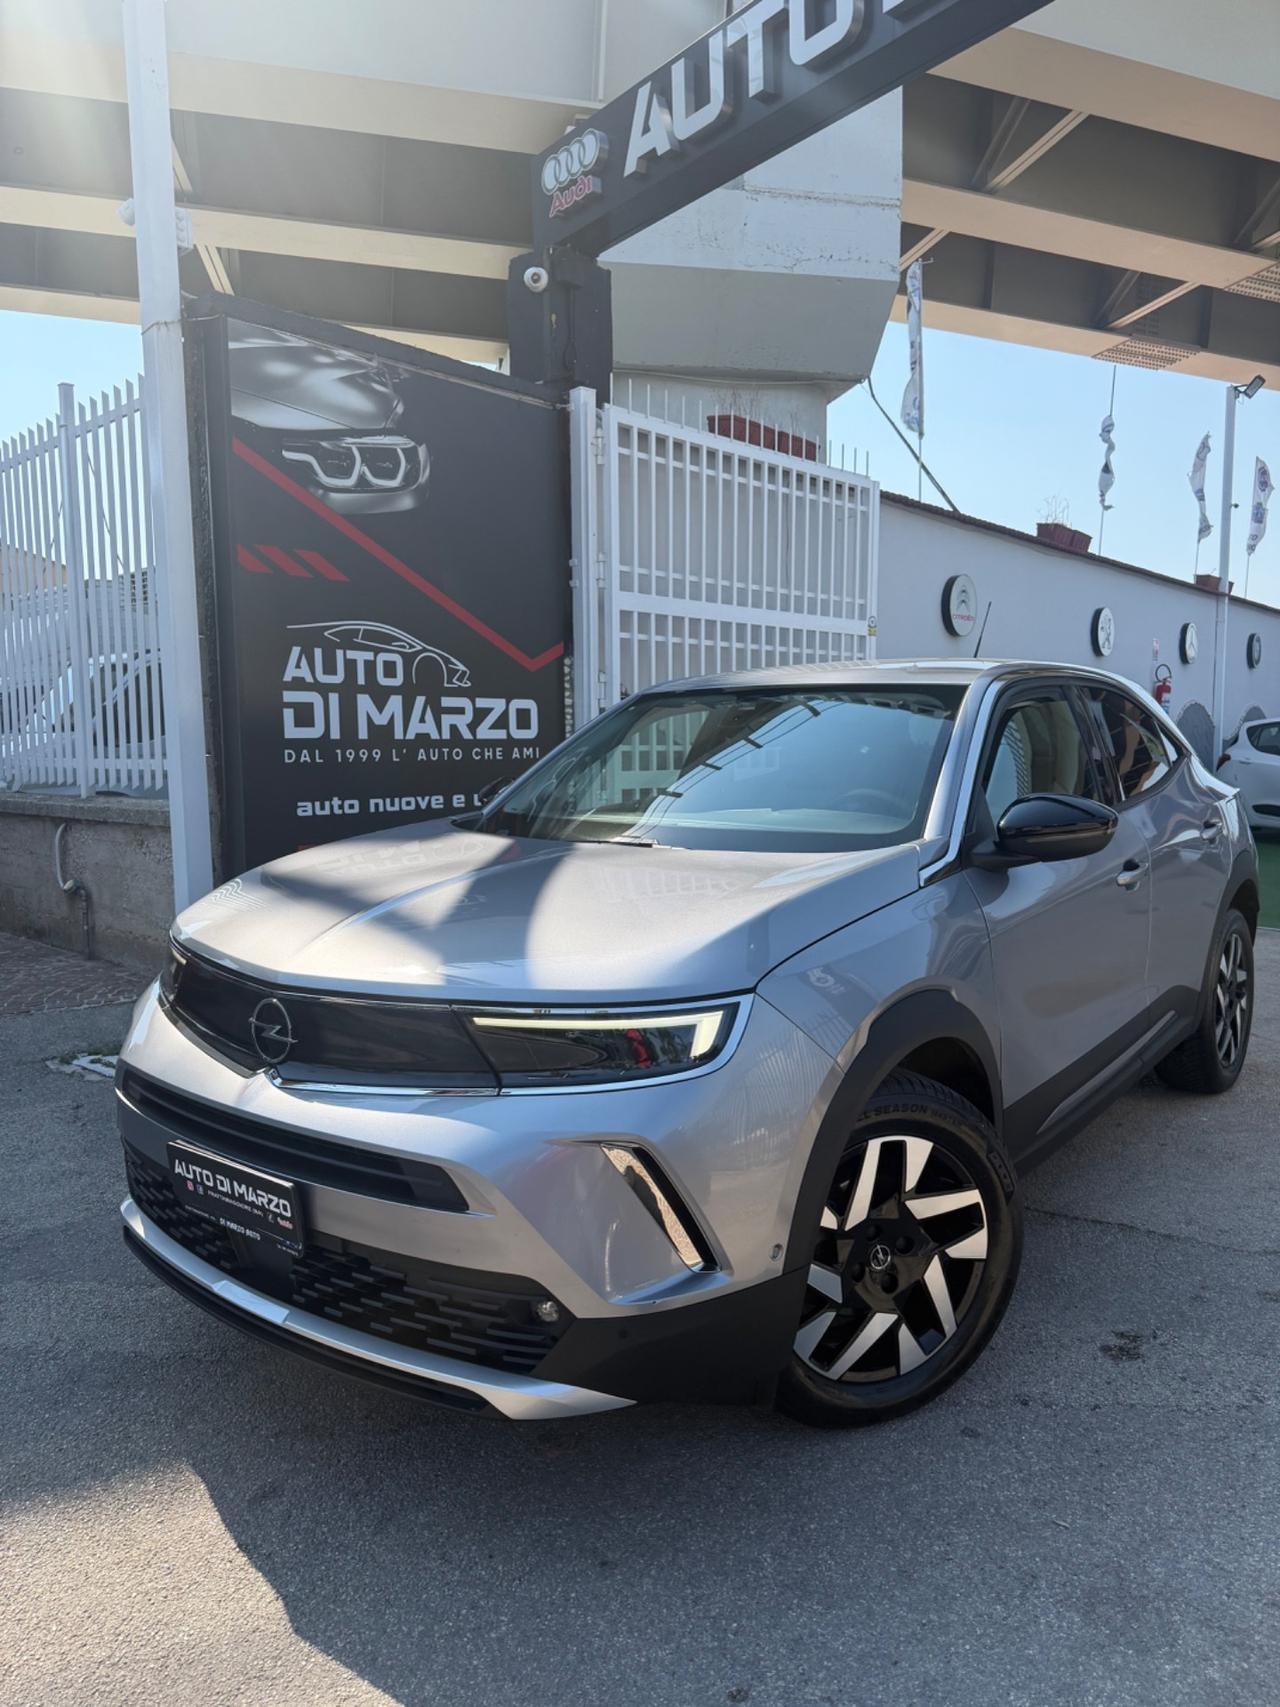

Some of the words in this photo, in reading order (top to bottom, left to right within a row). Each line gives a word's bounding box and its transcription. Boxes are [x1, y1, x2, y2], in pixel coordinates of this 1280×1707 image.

[623, 0, 855, 178] AUTO
[548, 174, 594, 218] Audi
[282, 645, 404, 687] AUTO
[282, 690, 341, 740] DI
[356, 694, 540, 740] MARZO
[284, 748, 324, 764] DAL
[335, 748, 382, 763] 1999
[391, 747, 408, 763] L'
[417, 747, 463, 762] AUTO
[471, 747, 504, 761] CHE
[511, 746, 540, 761] AMI
[296, 796, 360, 817] auto
[368, 794, 444, 813] nuove
[452, 793, 466, 808] e
[874, 1103, 929, 1116] SEASON
[174, 1158, 214, 1187] AUTO
[215, 1174, 232, 1194] DI
[233, 1180, 292, 1217] MARZO
